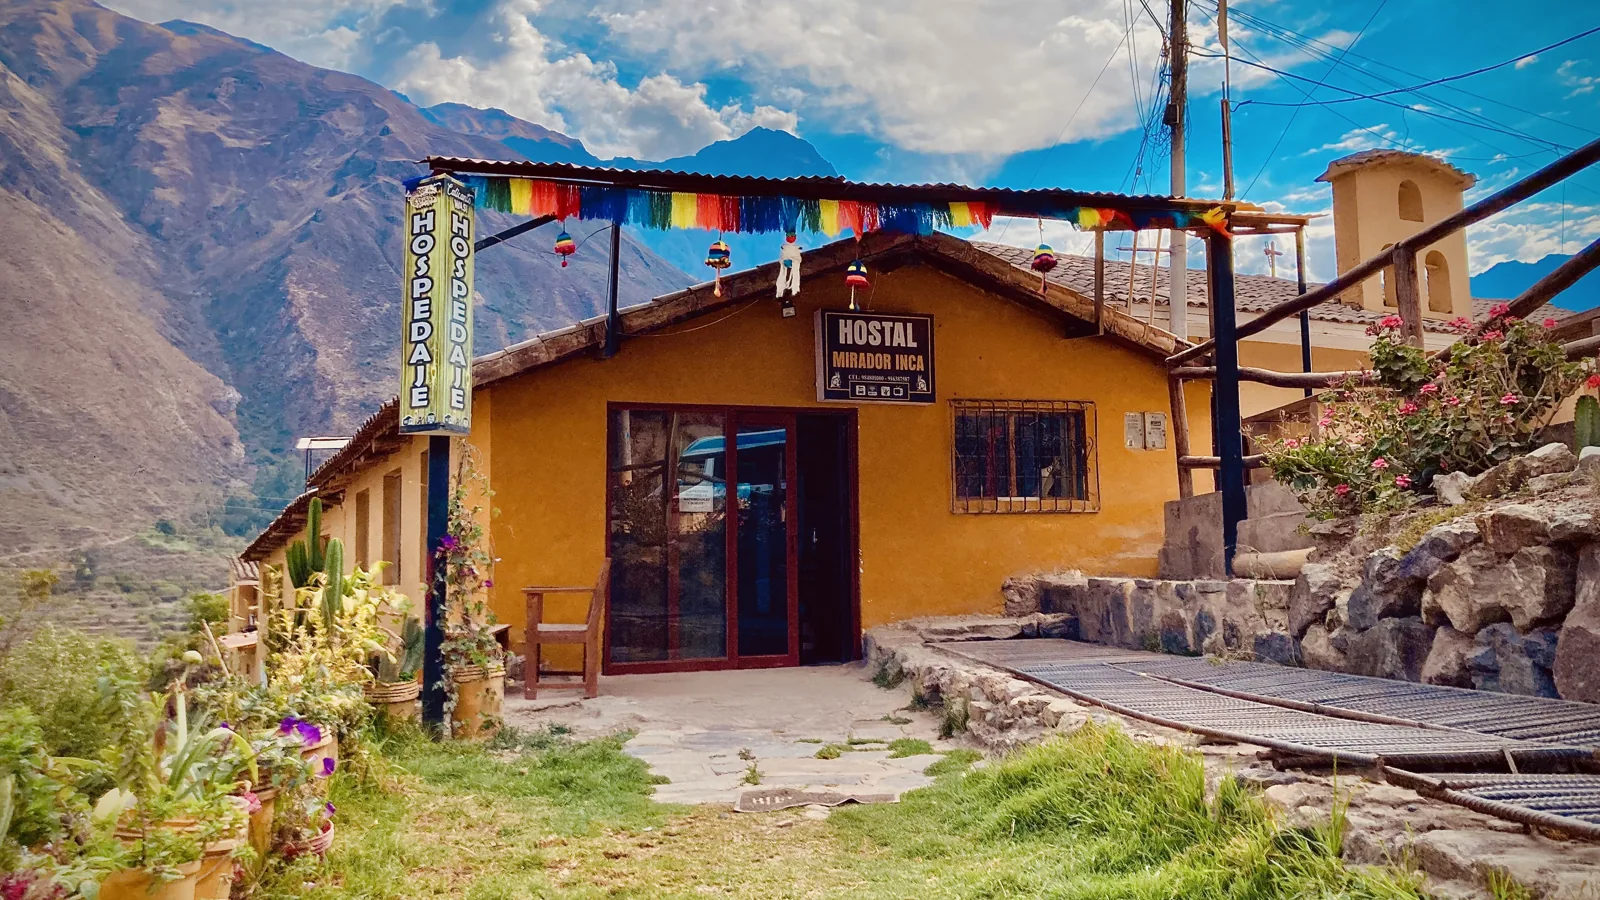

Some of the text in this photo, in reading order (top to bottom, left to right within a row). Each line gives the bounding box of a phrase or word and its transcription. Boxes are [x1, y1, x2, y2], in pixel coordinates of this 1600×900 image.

[409, 211, 435, 408] HOSPEDAJE
[450, 212, 470, 409] HOSPEDAJE
[832, 351, 925, 371] MIRADOR INCA
[839, 319, 917, 348] HOSTAL
